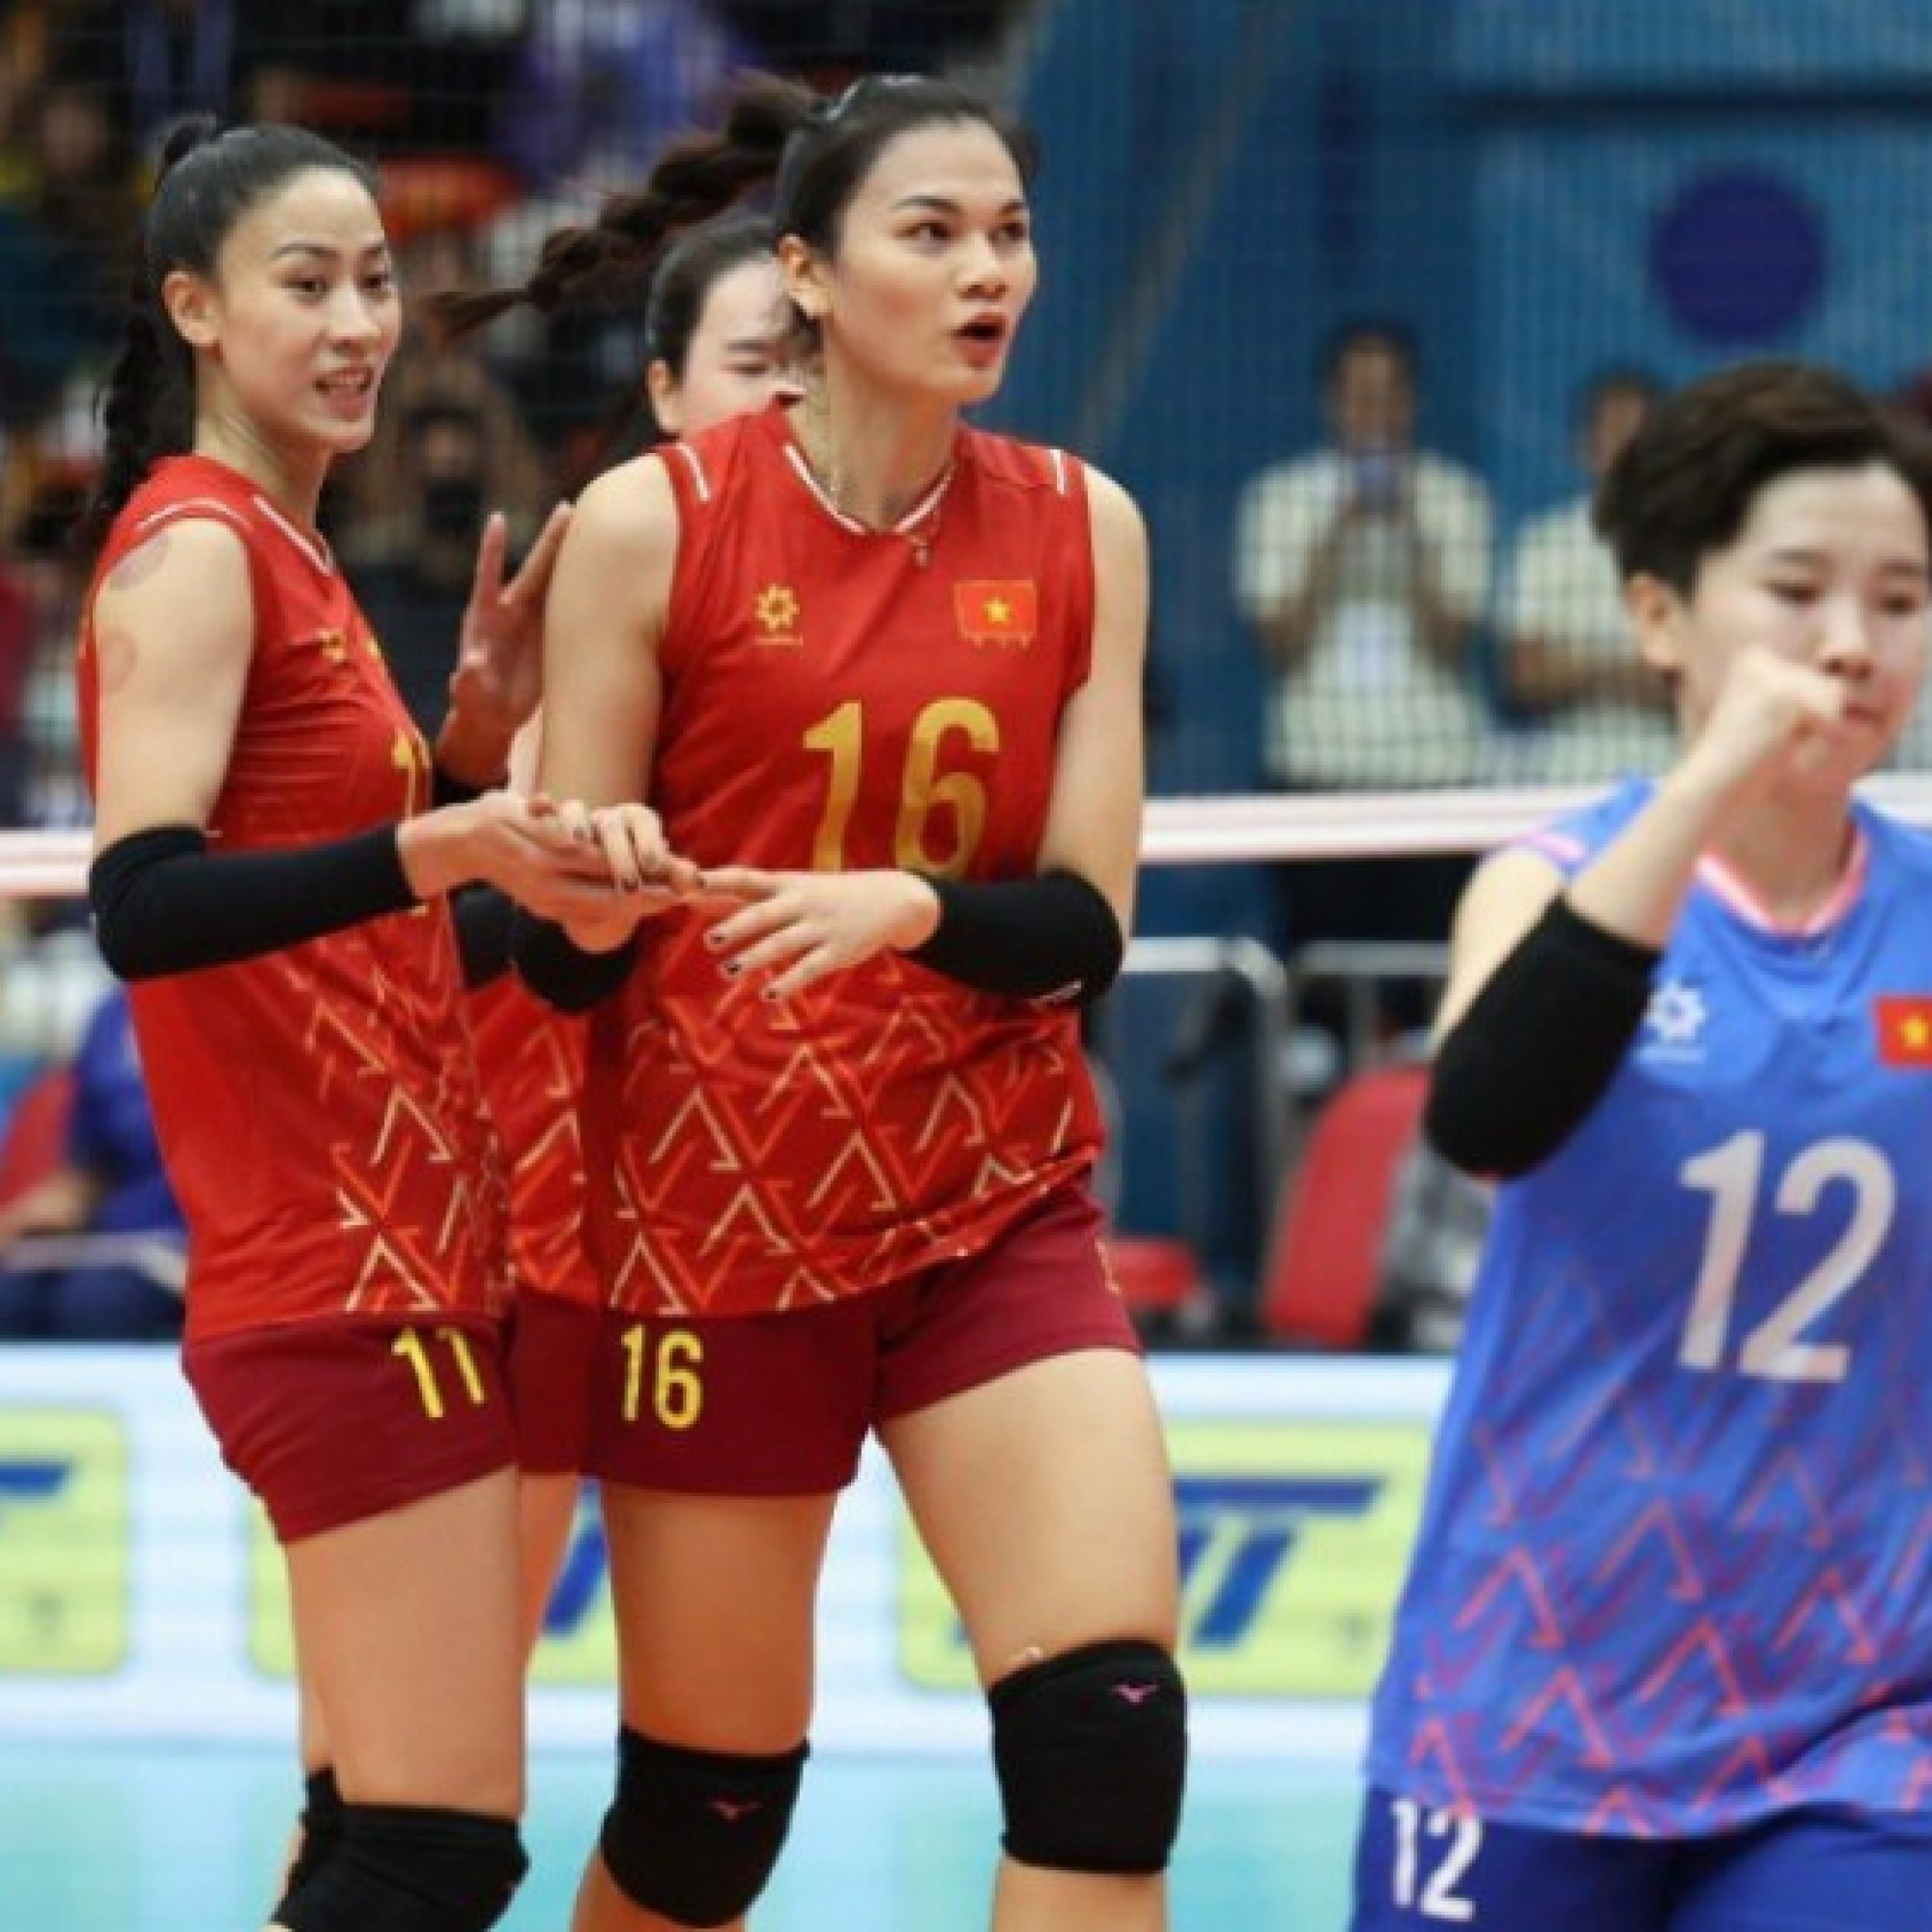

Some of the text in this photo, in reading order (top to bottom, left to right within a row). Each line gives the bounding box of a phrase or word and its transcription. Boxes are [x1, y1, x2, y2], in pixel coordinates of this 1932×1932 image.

[803, 696, 1000, 879] 16
[1680, 1128, 1896, 1381] 12
[391, 1326, 484, 1418] 11
[621, 1323, 704, 1430] 16
[1390, 1798, 1485, 1920] 12
